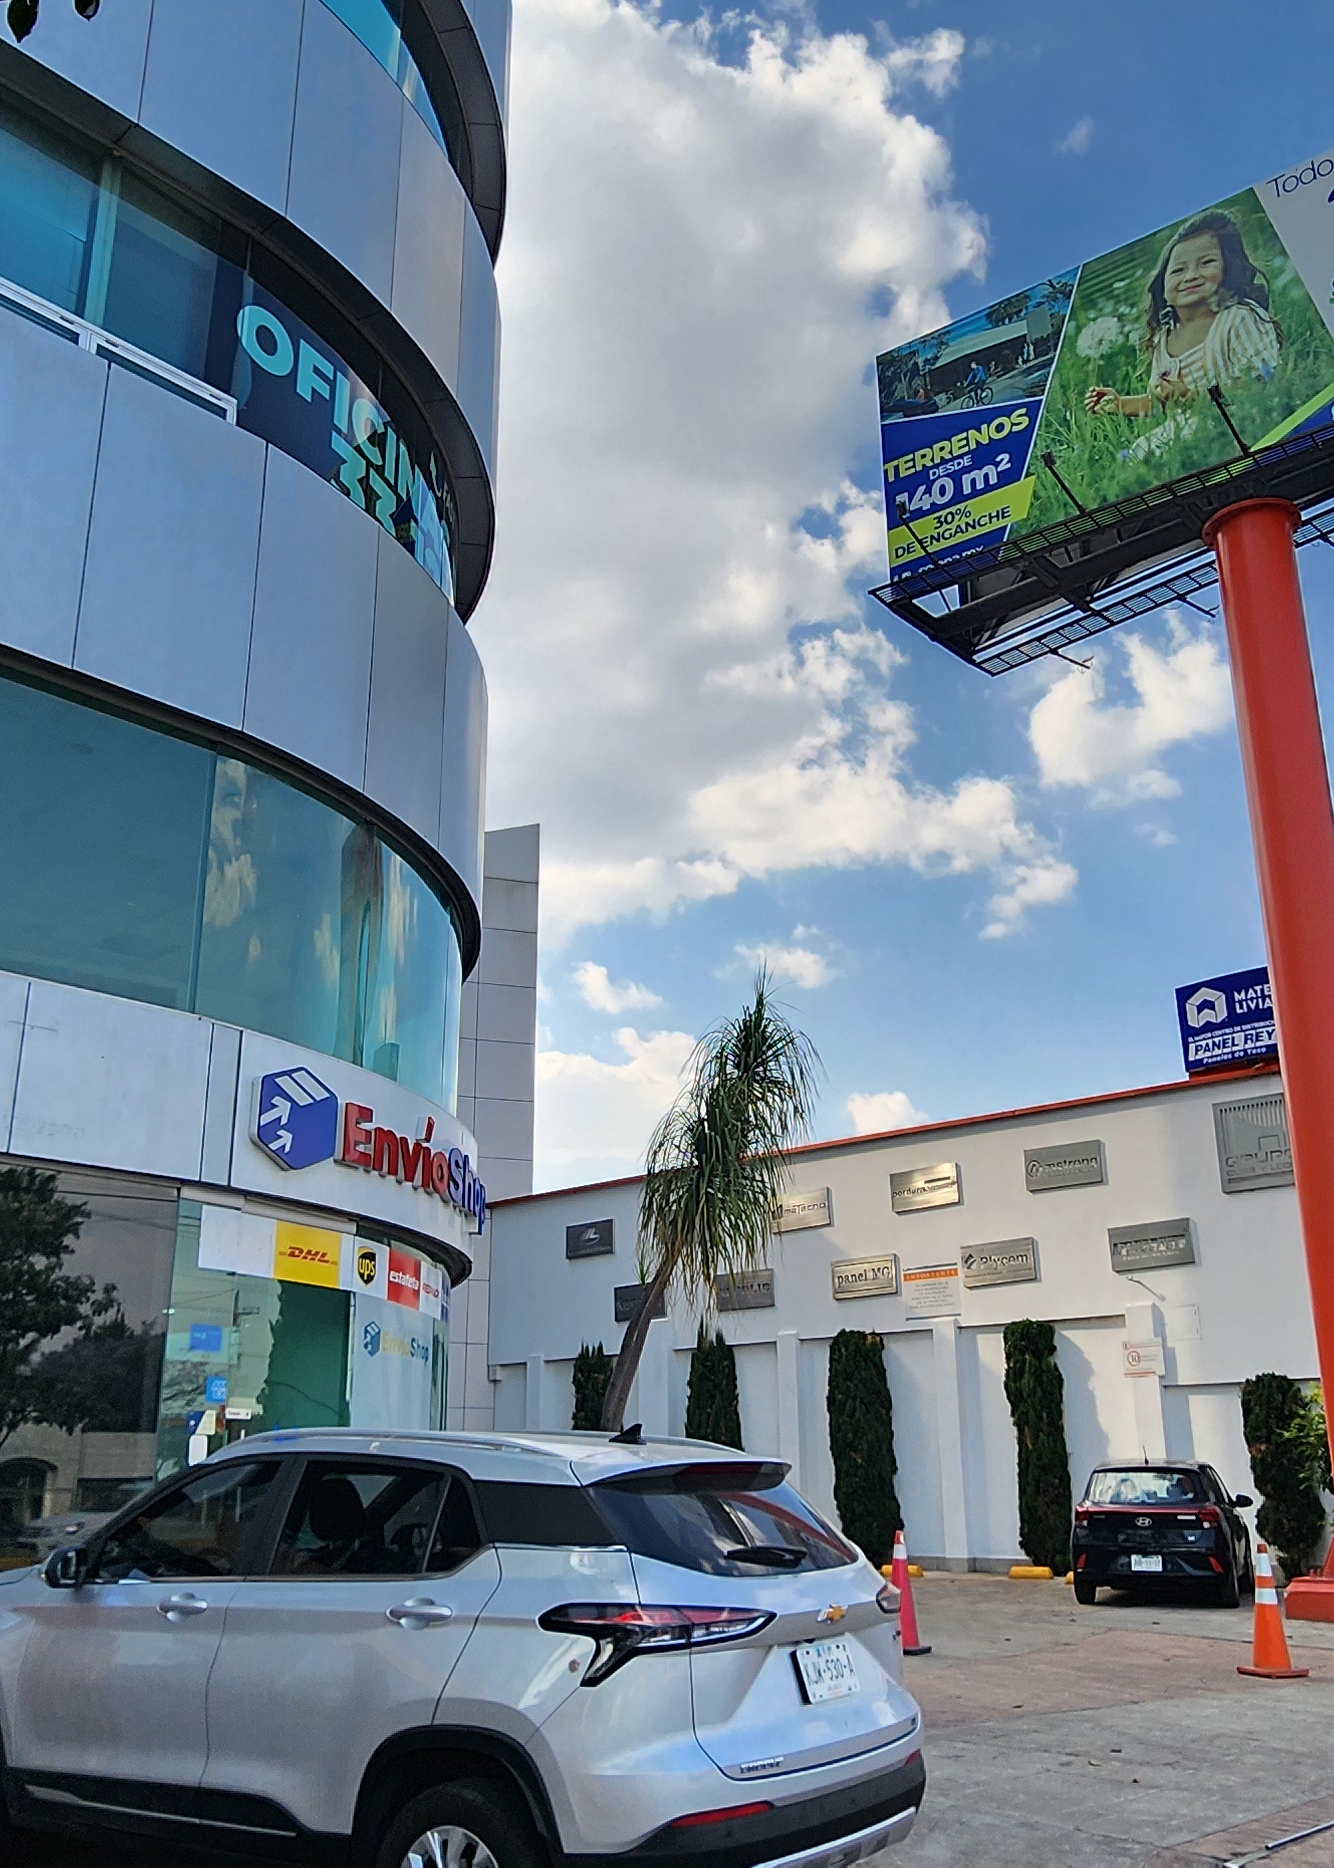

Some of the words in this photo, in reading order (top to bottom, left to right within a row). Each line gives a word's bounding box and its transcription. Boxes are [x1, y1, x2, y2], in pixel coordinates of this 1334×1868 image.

[1267, 160, 1334, 198] Todo
[884, 407, 1030, 482] TERRENOS
[929, 454, 973, 480] DESDE
[895, 476, 954, 519] 140
[933, 505, 972, 530] 30%
[894, 544, 917, 559] DE
[921, 505, 1012, 549] ENGANCHE
[1195, 1036, 1241, 1056] PANEL
[1244, 1028, 1276, 1046] REY
[286, 1245, 331, 1264] DHL
[358, 1258, 376, 1281] ups
